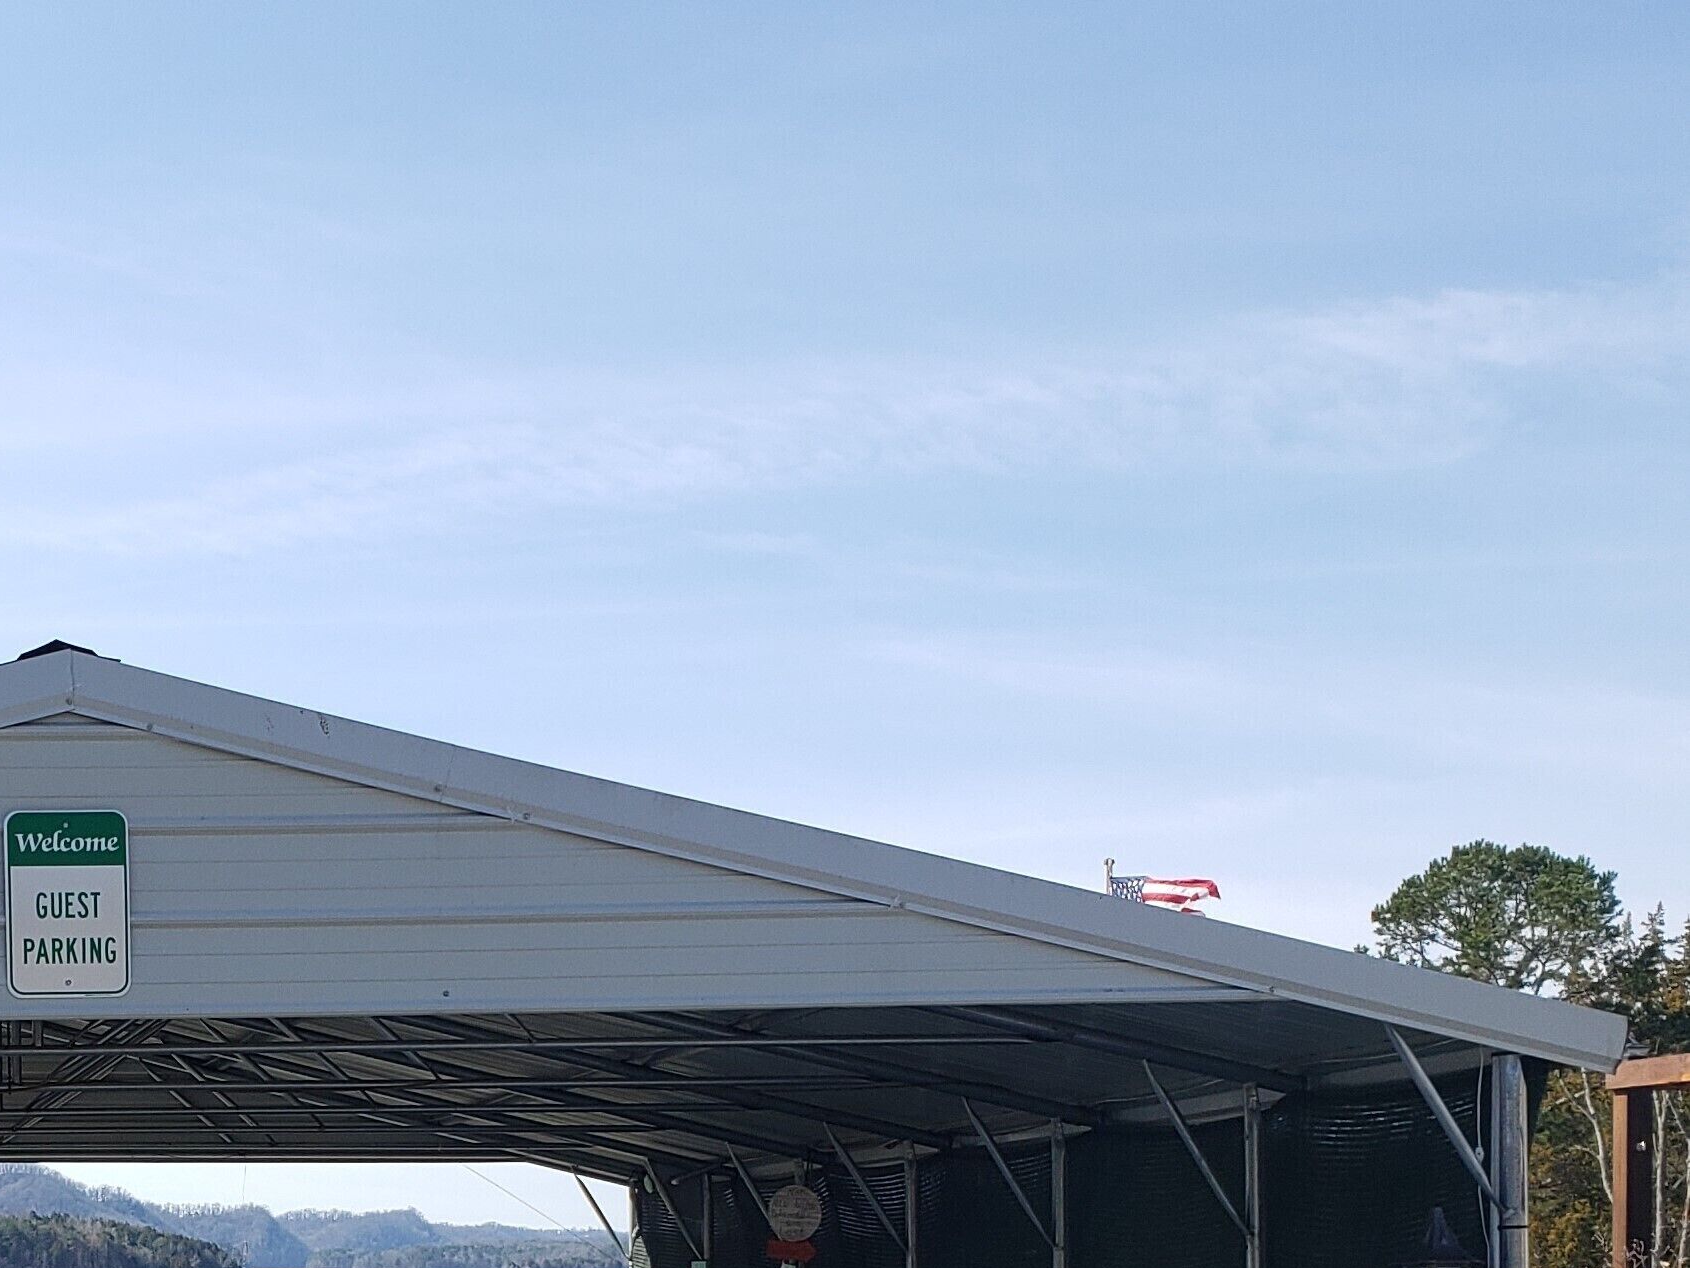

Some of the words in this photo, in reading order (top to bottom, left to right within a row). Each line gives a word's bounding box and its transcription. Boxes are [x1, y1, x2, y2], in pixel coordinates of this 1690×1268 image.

[15, 830, 120, 853] Welcome
[35, 891, 101, 919] GUEST
[23, 936, 117, 965] PARKING
